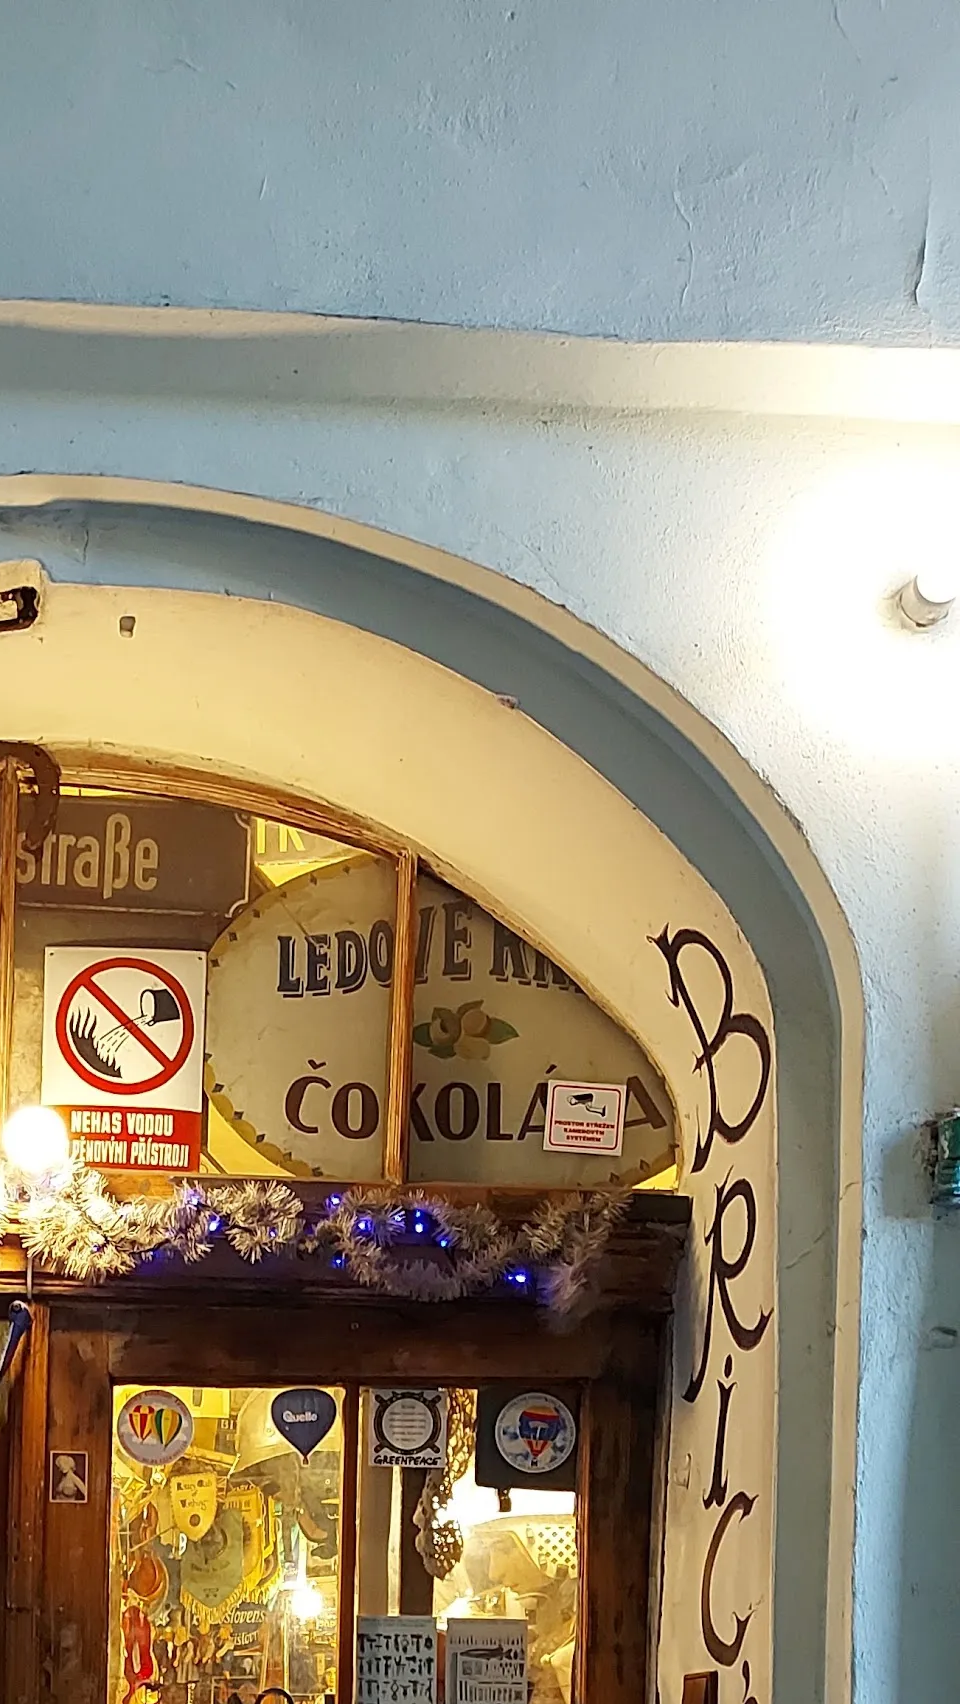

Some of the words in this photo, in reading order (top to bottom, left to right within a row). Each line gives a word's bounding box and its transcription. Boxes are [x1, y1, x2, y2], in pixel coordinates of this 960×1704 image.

[284, 1059, 667, 1142] ČOKOLÁA
[70, 1110, 122, 1134] NEHAS
[126, 1112, 174, 1137] VODOU
[130, 1136, 189, 1168] PŘÍSTROJI
[373, 1454, 442, 1466] GREENPEACE
